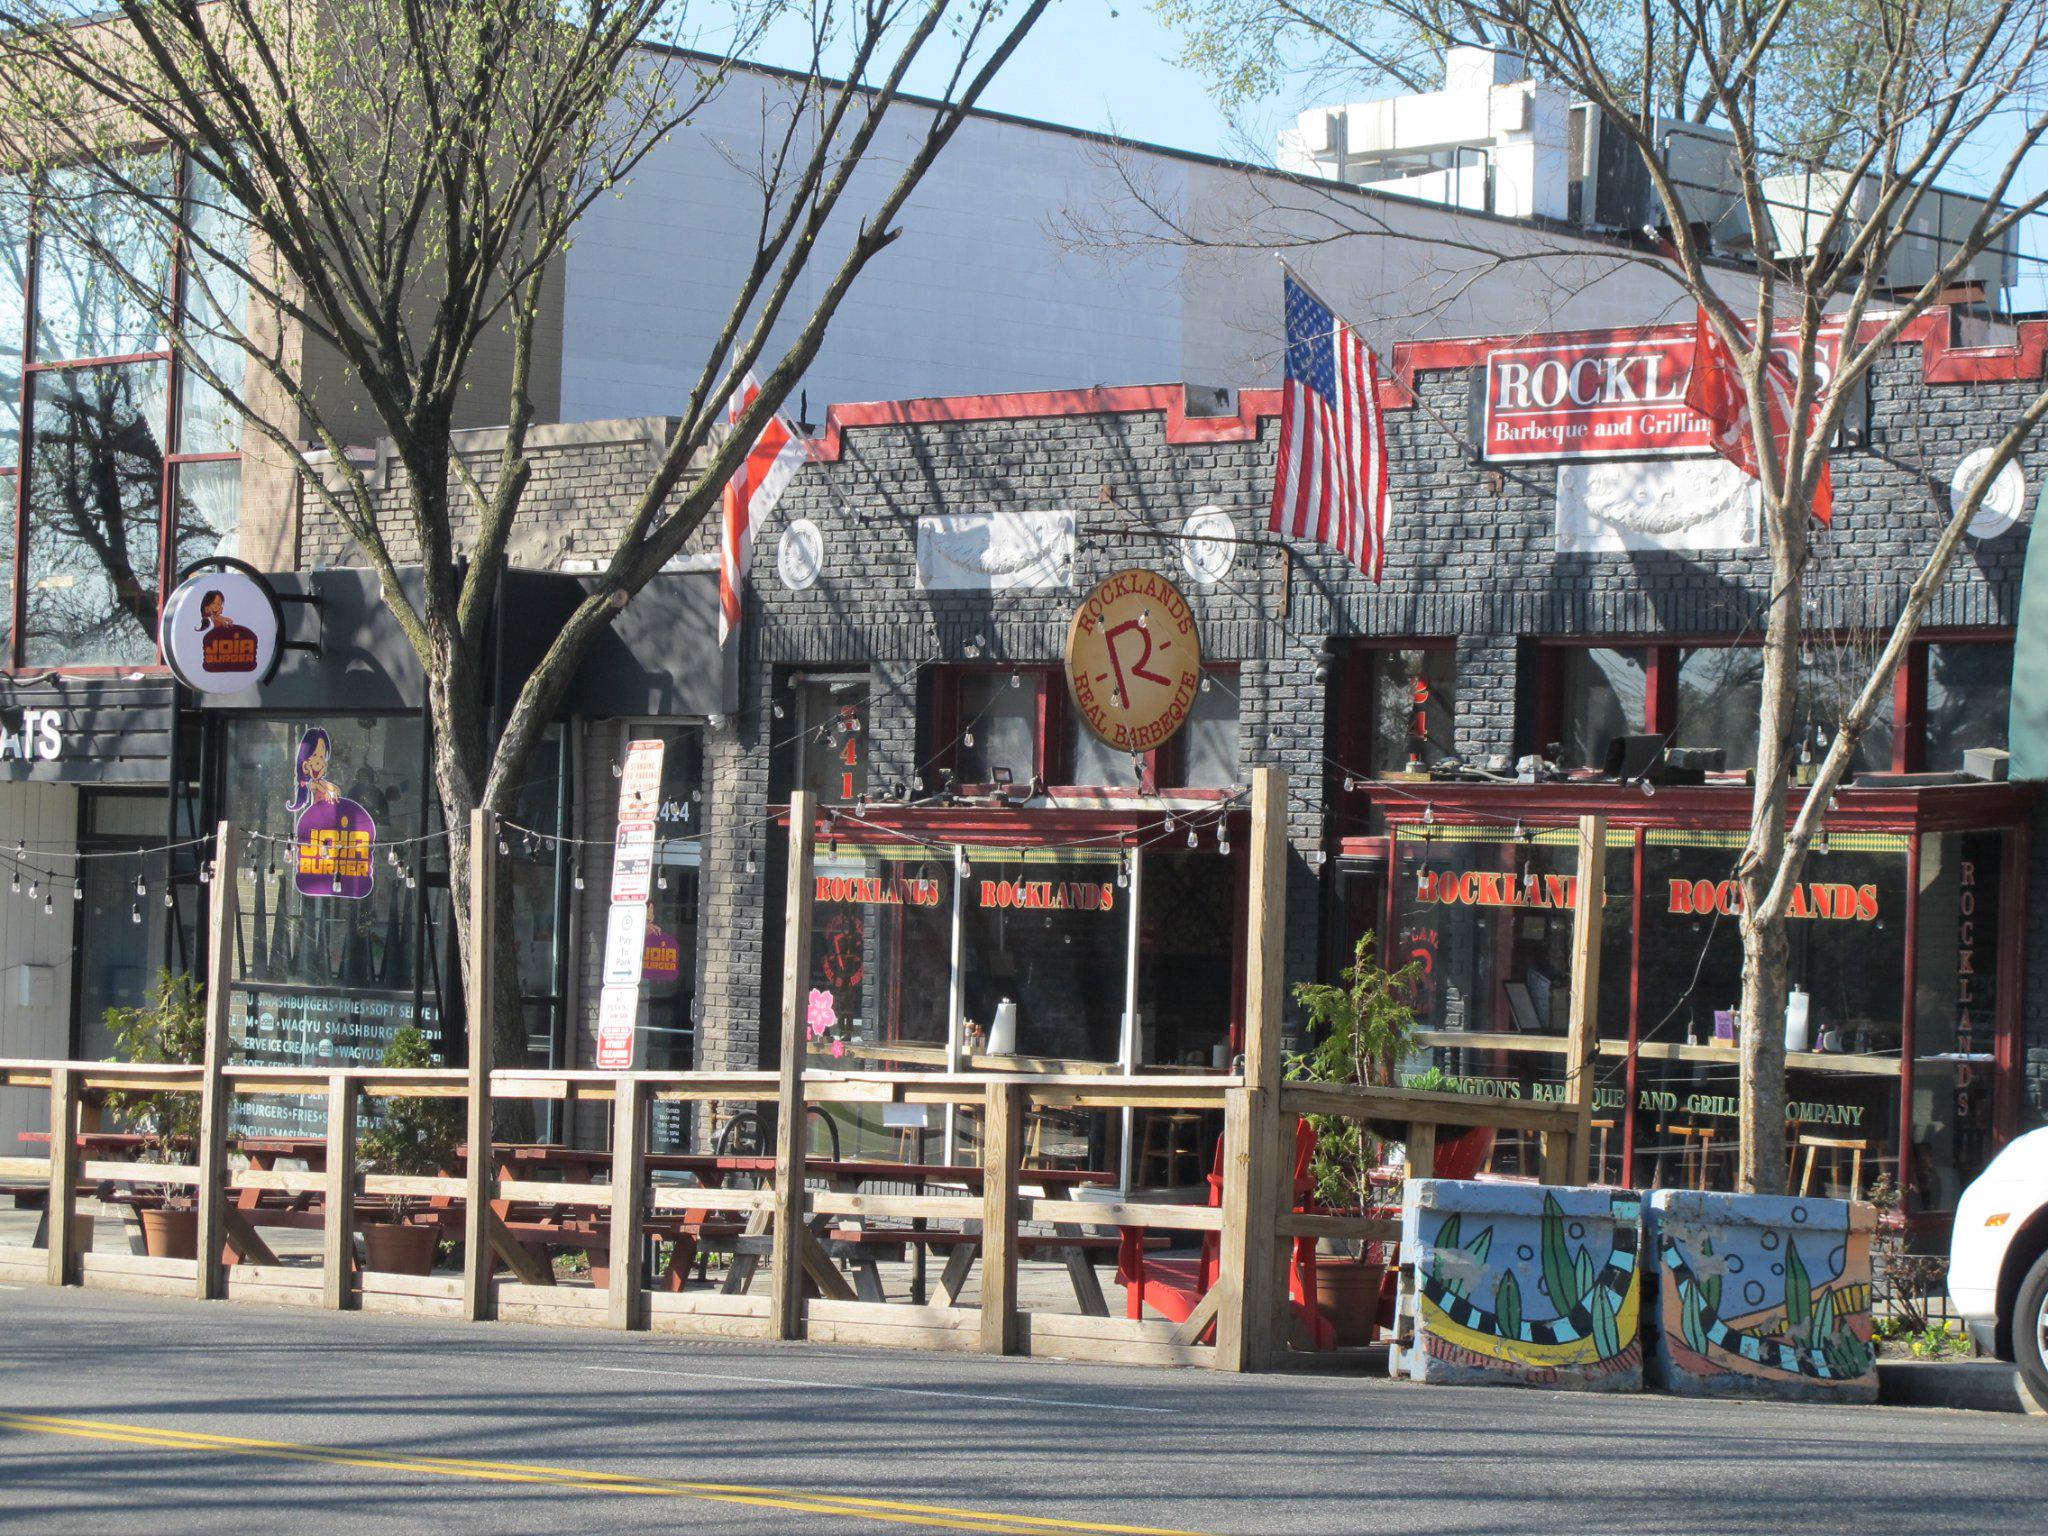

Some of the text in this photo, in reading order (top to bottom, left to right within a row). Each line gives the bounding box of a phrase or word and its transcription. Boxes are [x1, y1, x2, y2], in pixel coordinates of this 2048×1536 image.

[1495, 409, 1712, 447] Barbeque and Grillin
[1078, 574, 1194, 637] ROCKLANDS
[206, 654, 255, 663] BURGER
[1073, 670, 1198, 748] REAL BARBEQUE
[300, 858, 369, 876] BURGER
[815, 876, 939, 906] ROCKLANDS
[980, 880, 1114, 911] ROCKLANDS
[1416, 870, 1607, 909] ROCKLAN
[1668, 878, 1879, 921] ROCANDS
[1957, 861, 1976, 1117] ROCKLANDS
[257, 996, 333, 1012] SMASHBURGERS
[338, 1000, 365, 1015] FRIES
[370, 1002, 395, 1017] SOFT
[281, 1018, 320, 1033] WAGYU
[325, 1021, 398, 1040] SMASHBURG
[244, 1037, 266, 1051] ERVE
[268, 1038, 282, 1052] ICE
[283, 1039, 315, 1056] CREAM
[340, 1045, 374, 1060] WAGYU
[292, 1108, 318, 1123] FRIES
[1532, 1082, 1625, 1112] BARQUE
[1638, 1090, 1678, 1113] AND
[1785, 1101, 1865, 1126] OMPANY
